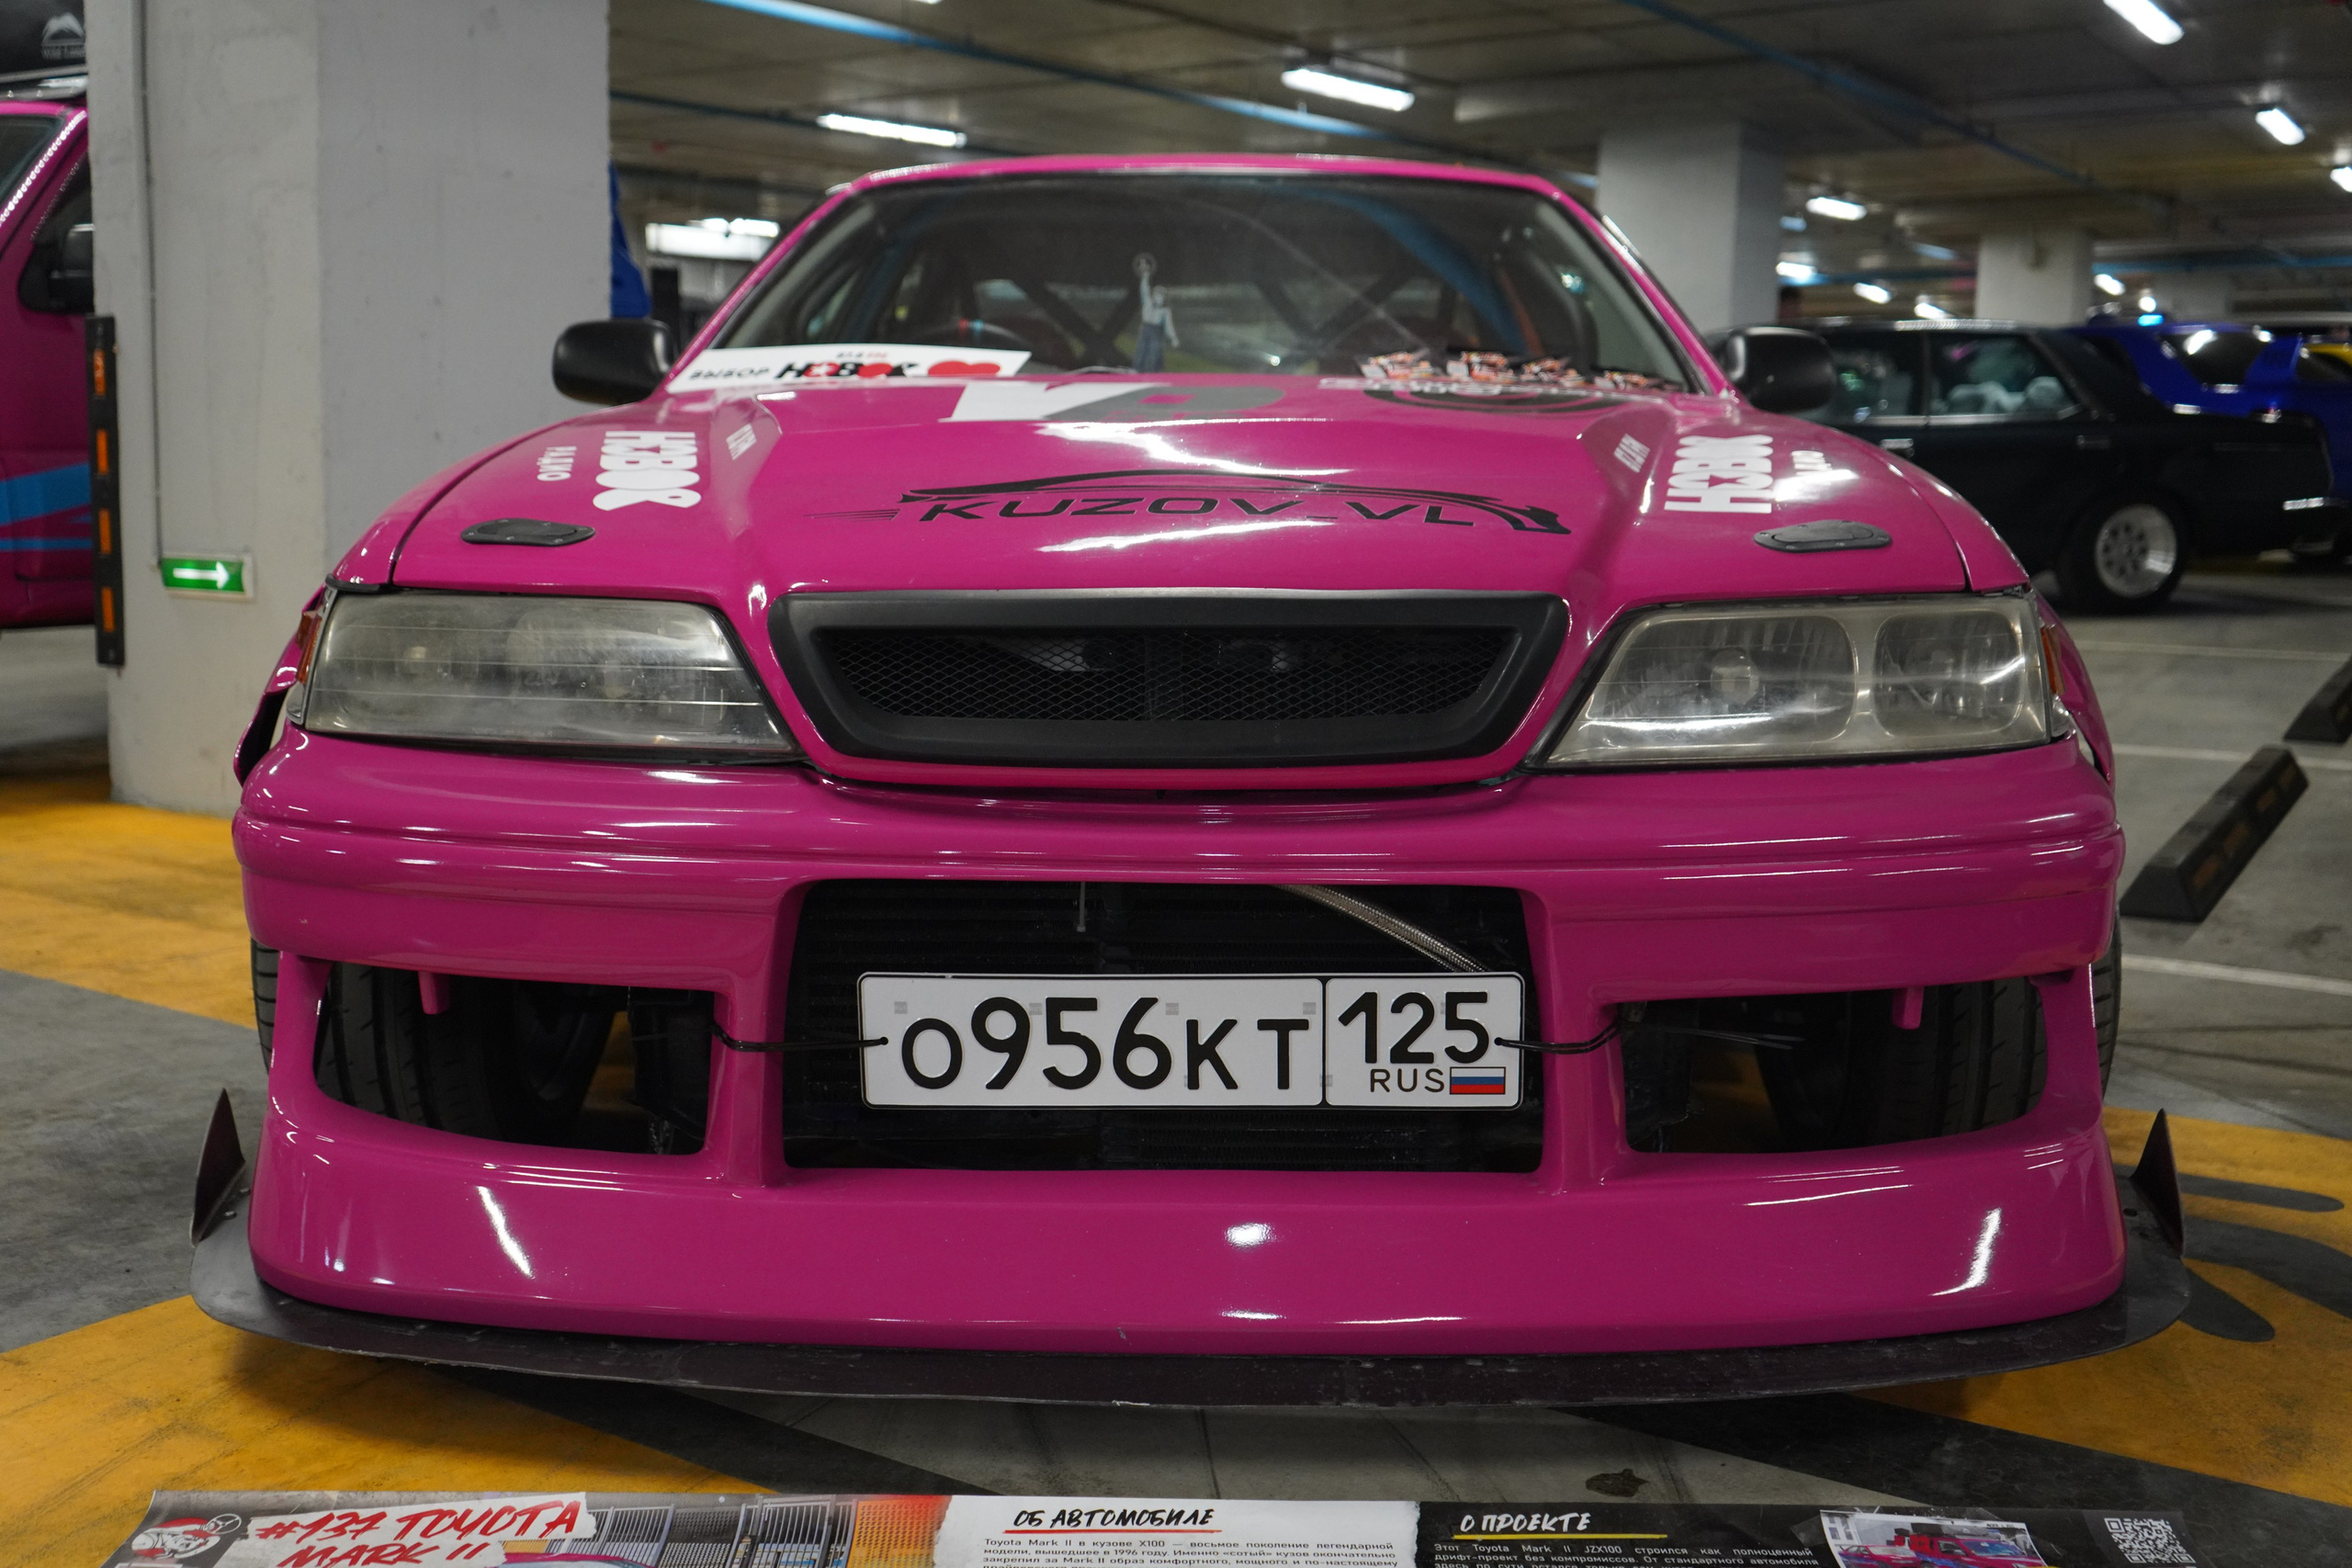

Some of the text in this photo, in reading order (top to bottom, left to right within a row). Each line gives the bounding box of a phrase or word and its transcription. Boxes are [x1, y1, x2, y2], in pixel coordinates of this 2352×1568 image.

[1338, 991, 1490, 1065] 125
[1369, 1067, 1446, 1093] RUS
[393, 1500, 582, 1540] TOYOTA
[1012, 1508, 1215, 1529] ОБ АВТОМОБИЛЕ
[1460, 1512, 1591, 1533] О ПРОЕКТЕ
[276, 1542, 439, 1568] MARK
[984, 1539, 1022, 1547] Toyota
[1028, 1539, 1058, 1547] Mark
[1317, 1542, 1394, 1551] легендарной
[1434, 1543, 1461, 1551] Этот
[1472, 1544, 1510, 1553] Toyota
[1584, 1545, 1623, 1554] JZX100
[1634, 1547, 1689, 1555] строился
[1733, 1548, 1814, 1557] полноценный
[1110, 1557, 1145, 1565] образ
[1149, 1558, 1231, 1566] комфортного,
[1305, 1560, 1398, 1568] по-настоящему
[1434, 1554, 1519, 1562] дрифт-проект
[1551, 1555, 1639, 1563] компромиссов.
[1644, 1555, 1657, 1563] От
[1664, 1557, 1745, 1565] стандартного
